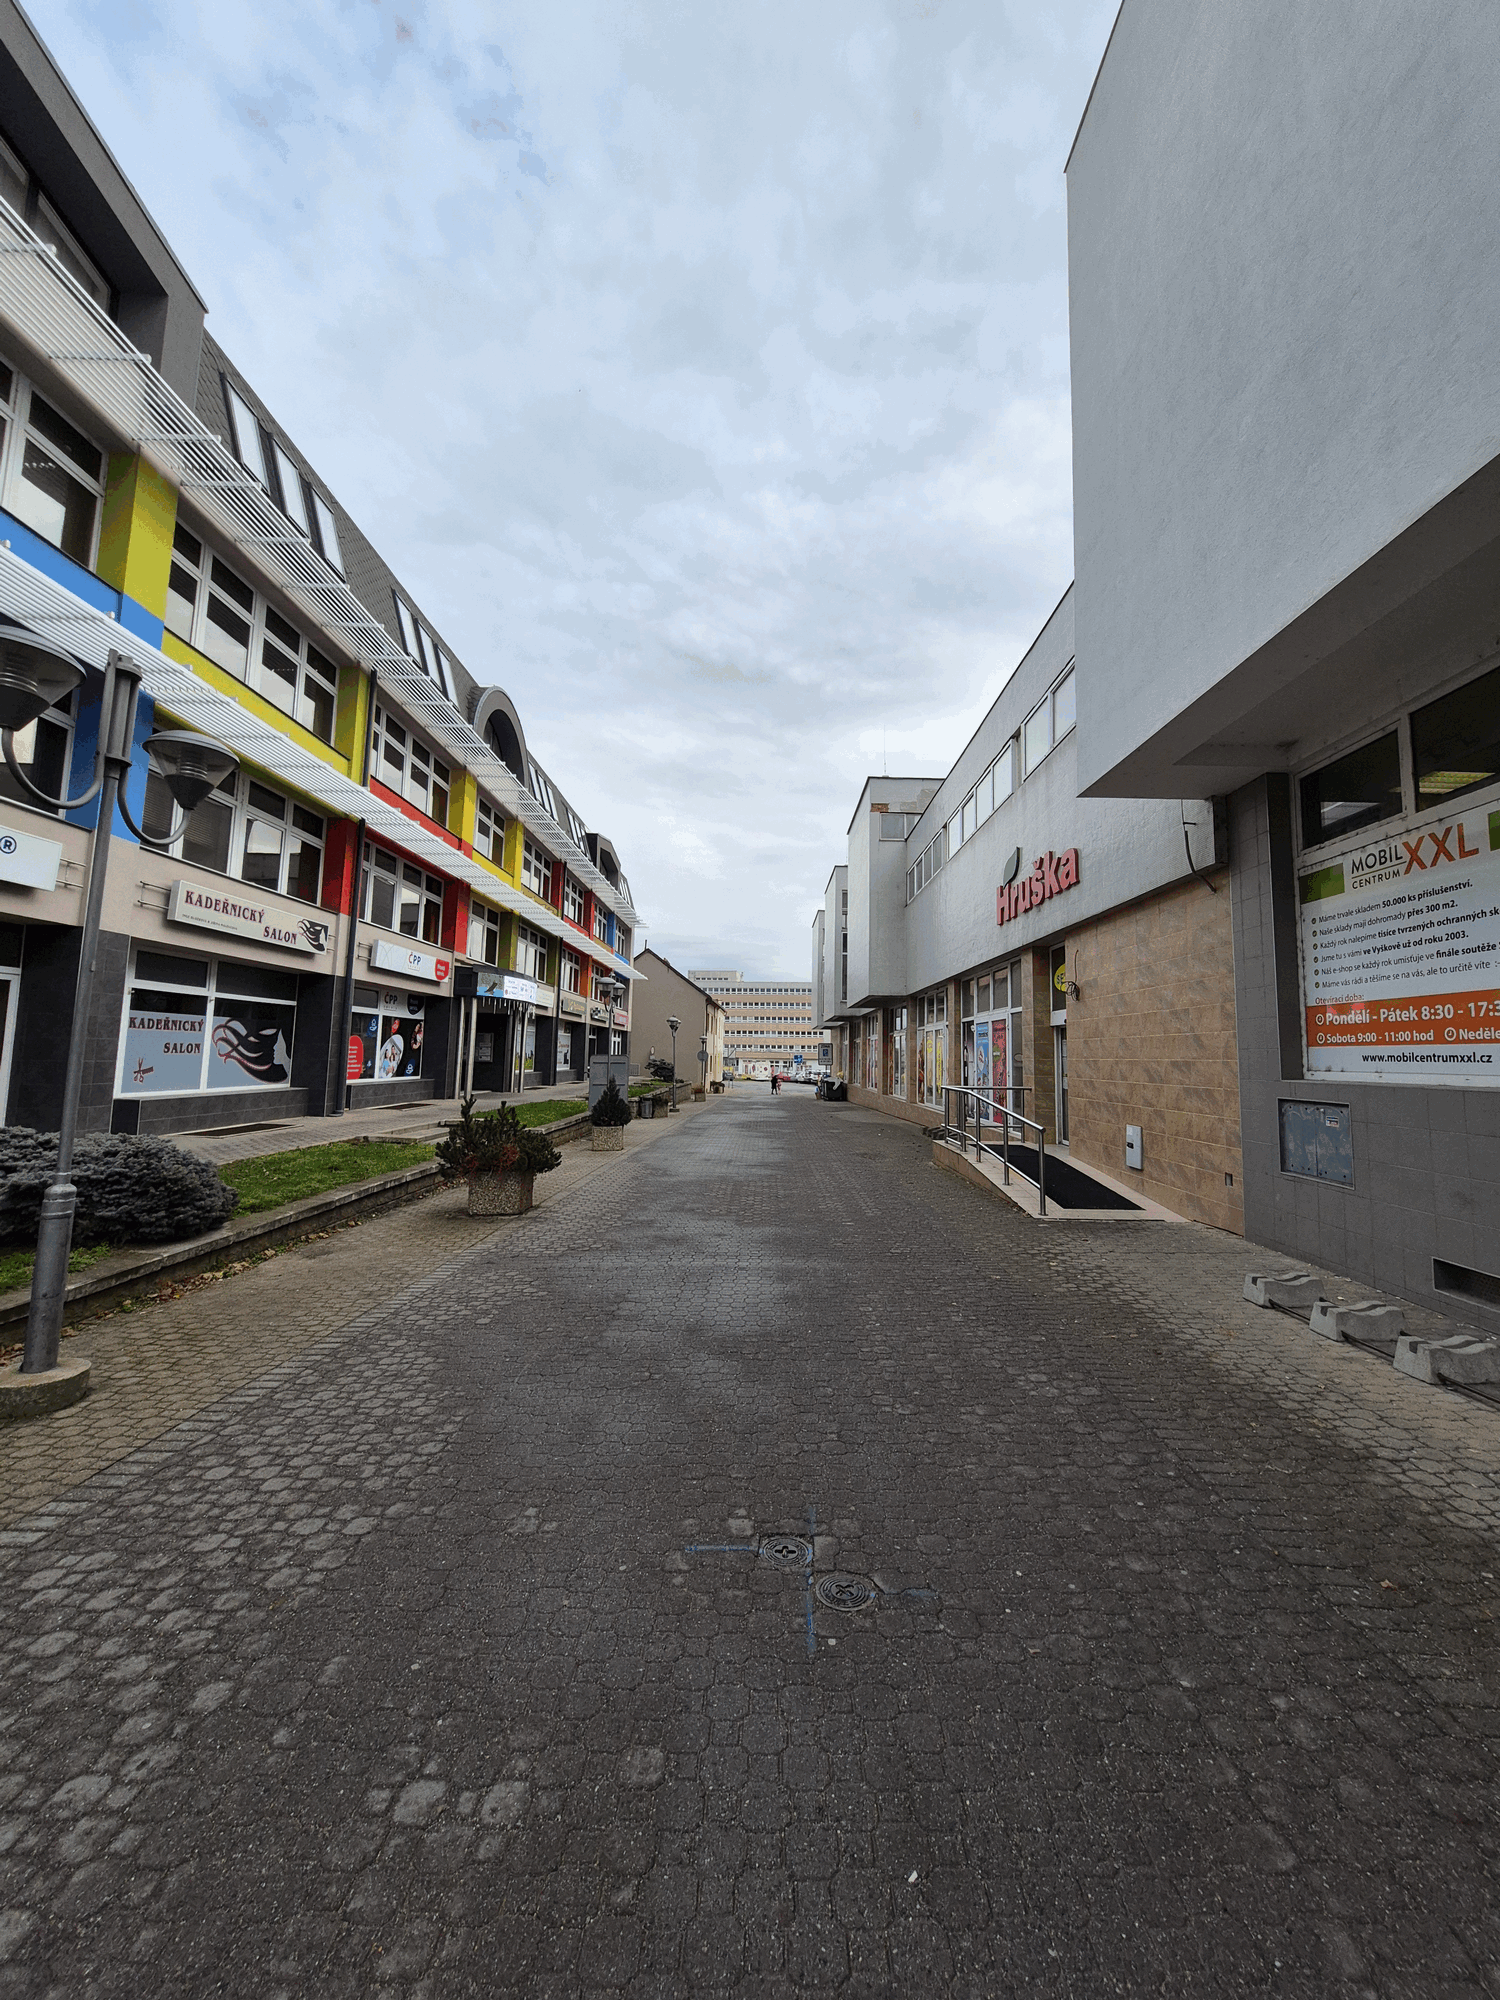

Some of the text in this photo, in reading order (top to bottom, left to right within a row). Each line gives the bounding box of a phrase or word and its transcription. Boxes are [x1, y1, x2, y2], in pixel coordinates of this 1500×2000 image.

[1351, 823, 1480, 876] MOBIL XXL
[997, 847, 1080, 926] Hruška
[1352, 868, 1401, 890] CENTRUM
[184, 890, 265, 924] KADEŘNICKÝ
[1354, 903, 1381, 915] skladem
[1382, 896, 1406, 908] 50.000
[1407, 894, 1417, 902] ks
[1417, 879, 1473, 901] příslušenství.
[1319, 929, 1334, 937] Naše
[1334, 923, 1352, 933] sklady
[1367, 911, 1406, 926] dohromady
[1407, 907, 1424, 919] přes
[1425, 903, 1440, 913] 300
[1442, 900, 1458, 910] m2.
[1398, 920, 1435, 934] tvrzených
[1436, 909, 1487, 927] ochranných
[1489, 907, 1500, 917] sk
[263, 926, 298, 945] SALON
[1372, 942, 1401, 955] Vyškově
[1402, 939, 1412, 949] už
[1412, 938, 1423, 947] od
[1424, 935, 1443, 945] roku
[1445, 930, 1469, 941] 2003.
[408, 951, 422, 966] ČPP
[1333, 965, 1354, 975] e-shop
[1361, 960, 1380, 971] každý
[1381, 958, 1392, 967] rok
[1425, 953, 1435, 961] ve
[1436, 948, 1460, 959] finále
[1461, 942, 1497, 955] soutěže
[1401, 971, 1411, 979] na
[1411, 968, 1425, 978] vás,
[1426, 966, 1438, 976] ale
[1439, 966, 1448, 974] to
[1449, 962, 1473, 974] určitě
[1474, 960, 1491, 971] víte
[384, 991, 398, 1005] ČPP
[129, 1016, 204, 1033] KADEŘNICKÝ
[1326, 1009, 1370, 1026] Pondělí
[1380, 1006, 1418, 1023] Pátek
[1421, 1004, 1454, 1020] 8:30
[1326, 1033, 1356, 1044] Sobota
[1357, 1032, 1377, 1043] 9:00
[1384, 1031, 1411, 1042] 11:00
[1413, 1029, 1434, 1041] hod
[1459, 1027, 1500, 1041] Neděle
[163, 1042, 201, 1054] SALON
[1362, 1052, 1493, 1064] www.mobilcentrumxxl.cz
